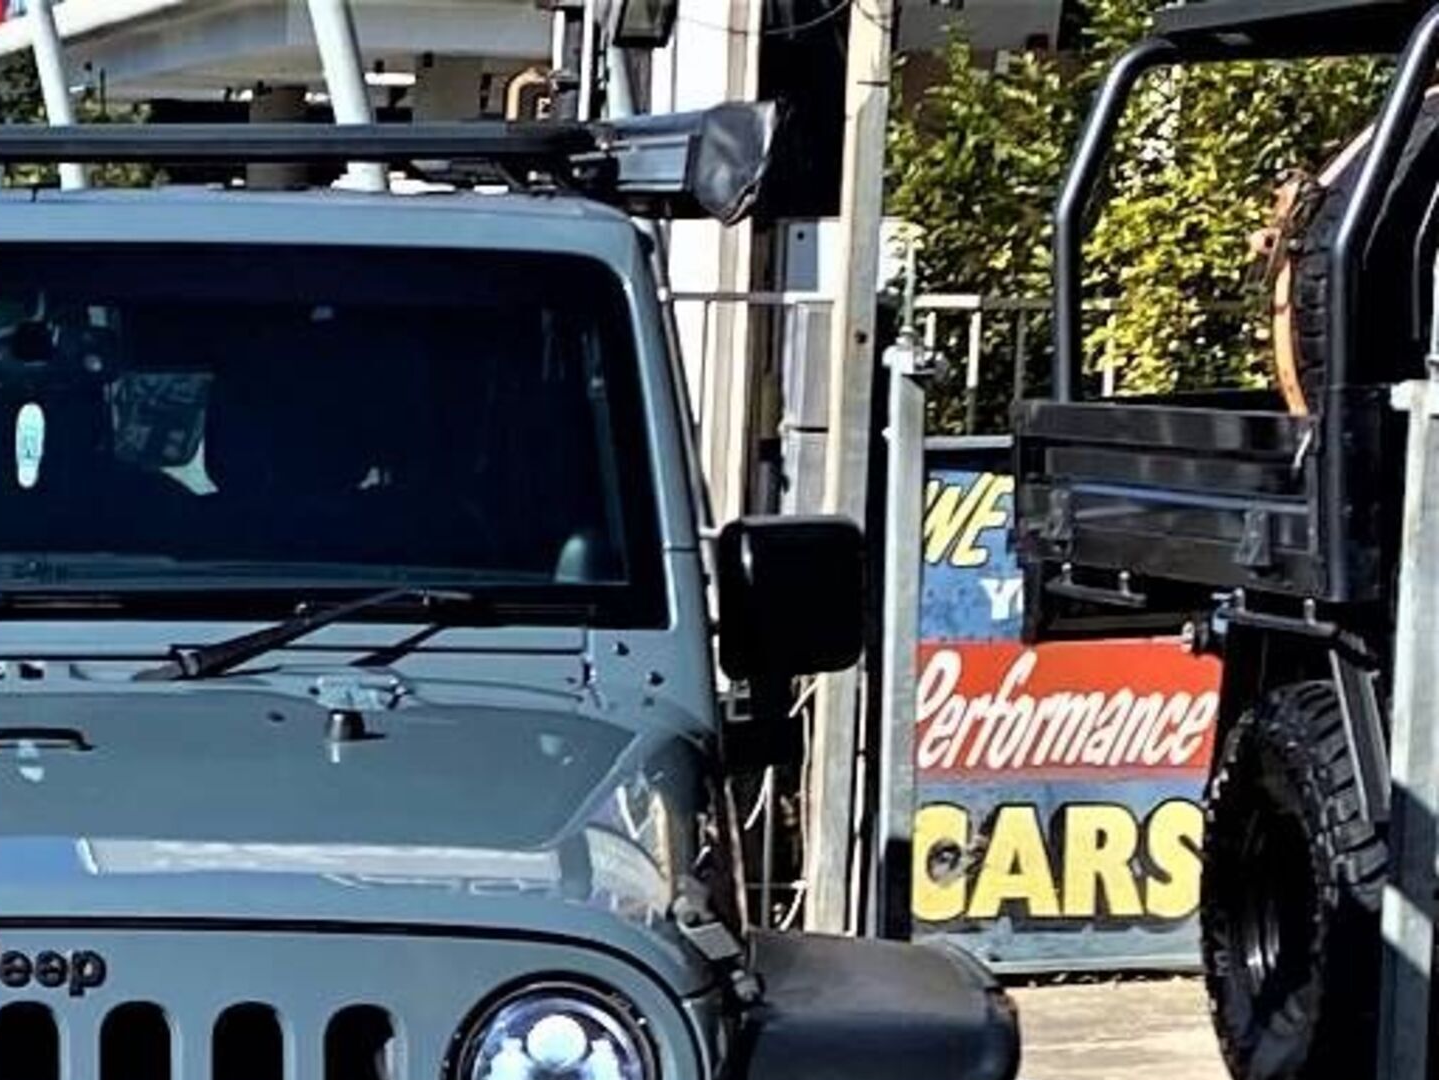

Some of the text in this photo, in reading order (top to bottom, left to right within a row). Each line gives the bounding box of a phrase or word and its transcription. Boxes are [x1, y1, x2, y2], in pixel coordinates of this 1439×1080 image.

[924, 472, 1015, 567] WE
[979, 577, 1023, 620] Y
[915, 649, 1219, 769] Performance
[912, 800, 1204, 920] CARS
